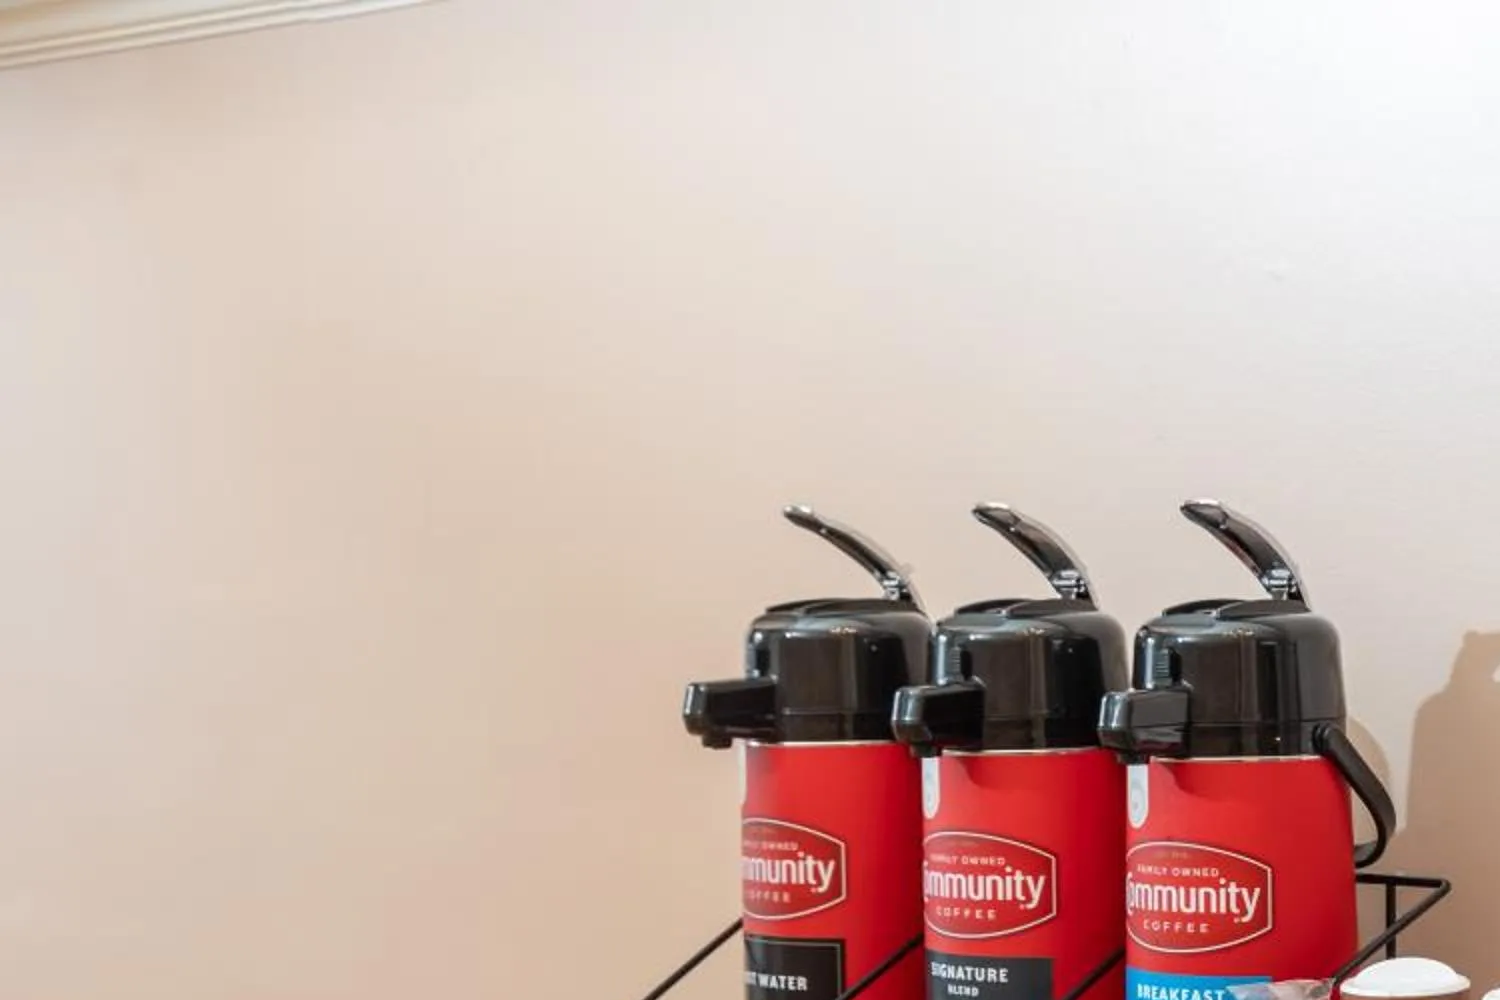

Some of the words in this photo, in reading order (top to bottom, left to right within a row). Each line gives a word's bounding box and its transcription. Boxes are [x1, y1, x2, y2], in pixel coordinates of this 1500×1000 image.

[961, 856, 1006, 866] OWNED
[1171, 867, 1219, 878] OWNED
[936, 906, 997, 920] COFFEE
[1143, 919, 1210, 934] COFFEE
[931, 961, 1009, 983] SIGNATURE
[757, 974, 808, 991] WATER
[948, 984, 979, 997] BLEND
